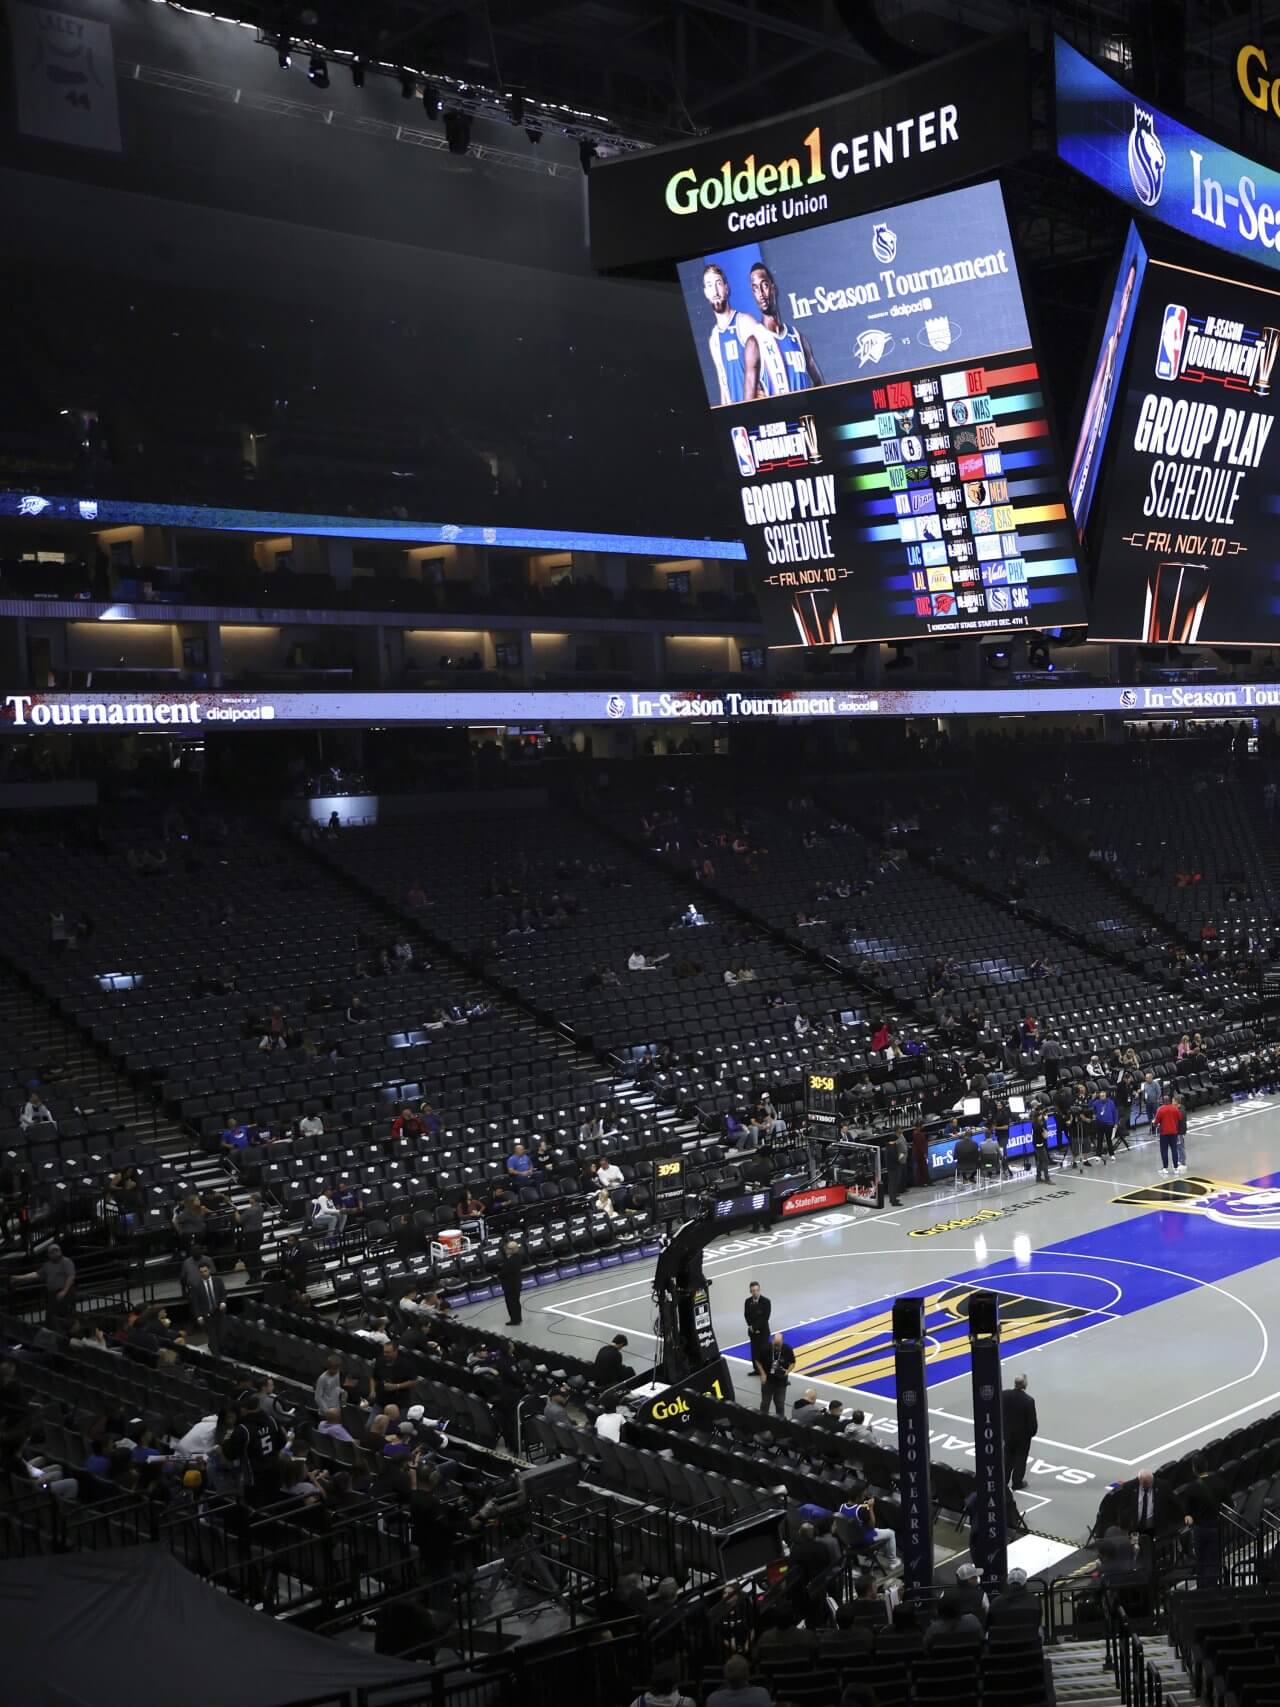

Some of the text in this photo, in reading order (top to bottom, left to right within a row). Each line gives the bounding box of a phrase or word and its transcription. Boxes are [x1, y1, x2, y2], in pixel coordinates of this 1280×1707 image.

[830, 104, 960, 180] CENTER
[728, 194, 829, 232] Credit Union
[788, 249, 1009, 320] In-Season Tournament
[1204, 316, 1245, 341] IN-SEASON
[1181, 325, 1266, 386] TOURNAMENT
[968, 371, 983, 393] DET
[972, 399, 990, 420] WAS
[878, 416, 895, 436] CHA
[979, 426, 995, 447] BOS
[1134, 394, 1275, 468] GROUP PLAY
[883, 442, 900, 463] BKN
[889, 468, 905, 488] NOP
[741, 475, 836, 525] GROUP PLAY
[1143, 460, 1245, 525] SCHEDULE
[997, 509, 1013, 528] SAS
[764, 520, 834, 565] SCHEDULE
[1002, 535, 1018, 555] DAL
[1145, 531, 1226, 556] FRI, NOV. 10
[907, 546, 922, 566] LAC
[800, 569, 824, 584] NOV.
[825, 568, 837, 582] 10
[912, 571, 927, 591] LAL
[1008, 562, 1024, 582] PHX
[1012, 588, 1029, 608] SAC
[931, 621, 959, 632] KNOCKOUT
[960, 620, 977, 630] STAGE
[977, 619, 998, 629] STARTS
[631, 693, 836, 717] In-Season Tournament
[1143, 687, 1238, 708] In-Season
[6, 695, 201, 726] Tournament
[206, 705, 261, 724] dialpad
[1001, 1189, 1075, 1213] CENTER
[907, 1418, 917, 1462] 100
[984, 1412, 994, 1455] 100
[908, 1471, 920, 1545] YEARS
[986, 1465, 996, 1538] YEARS
